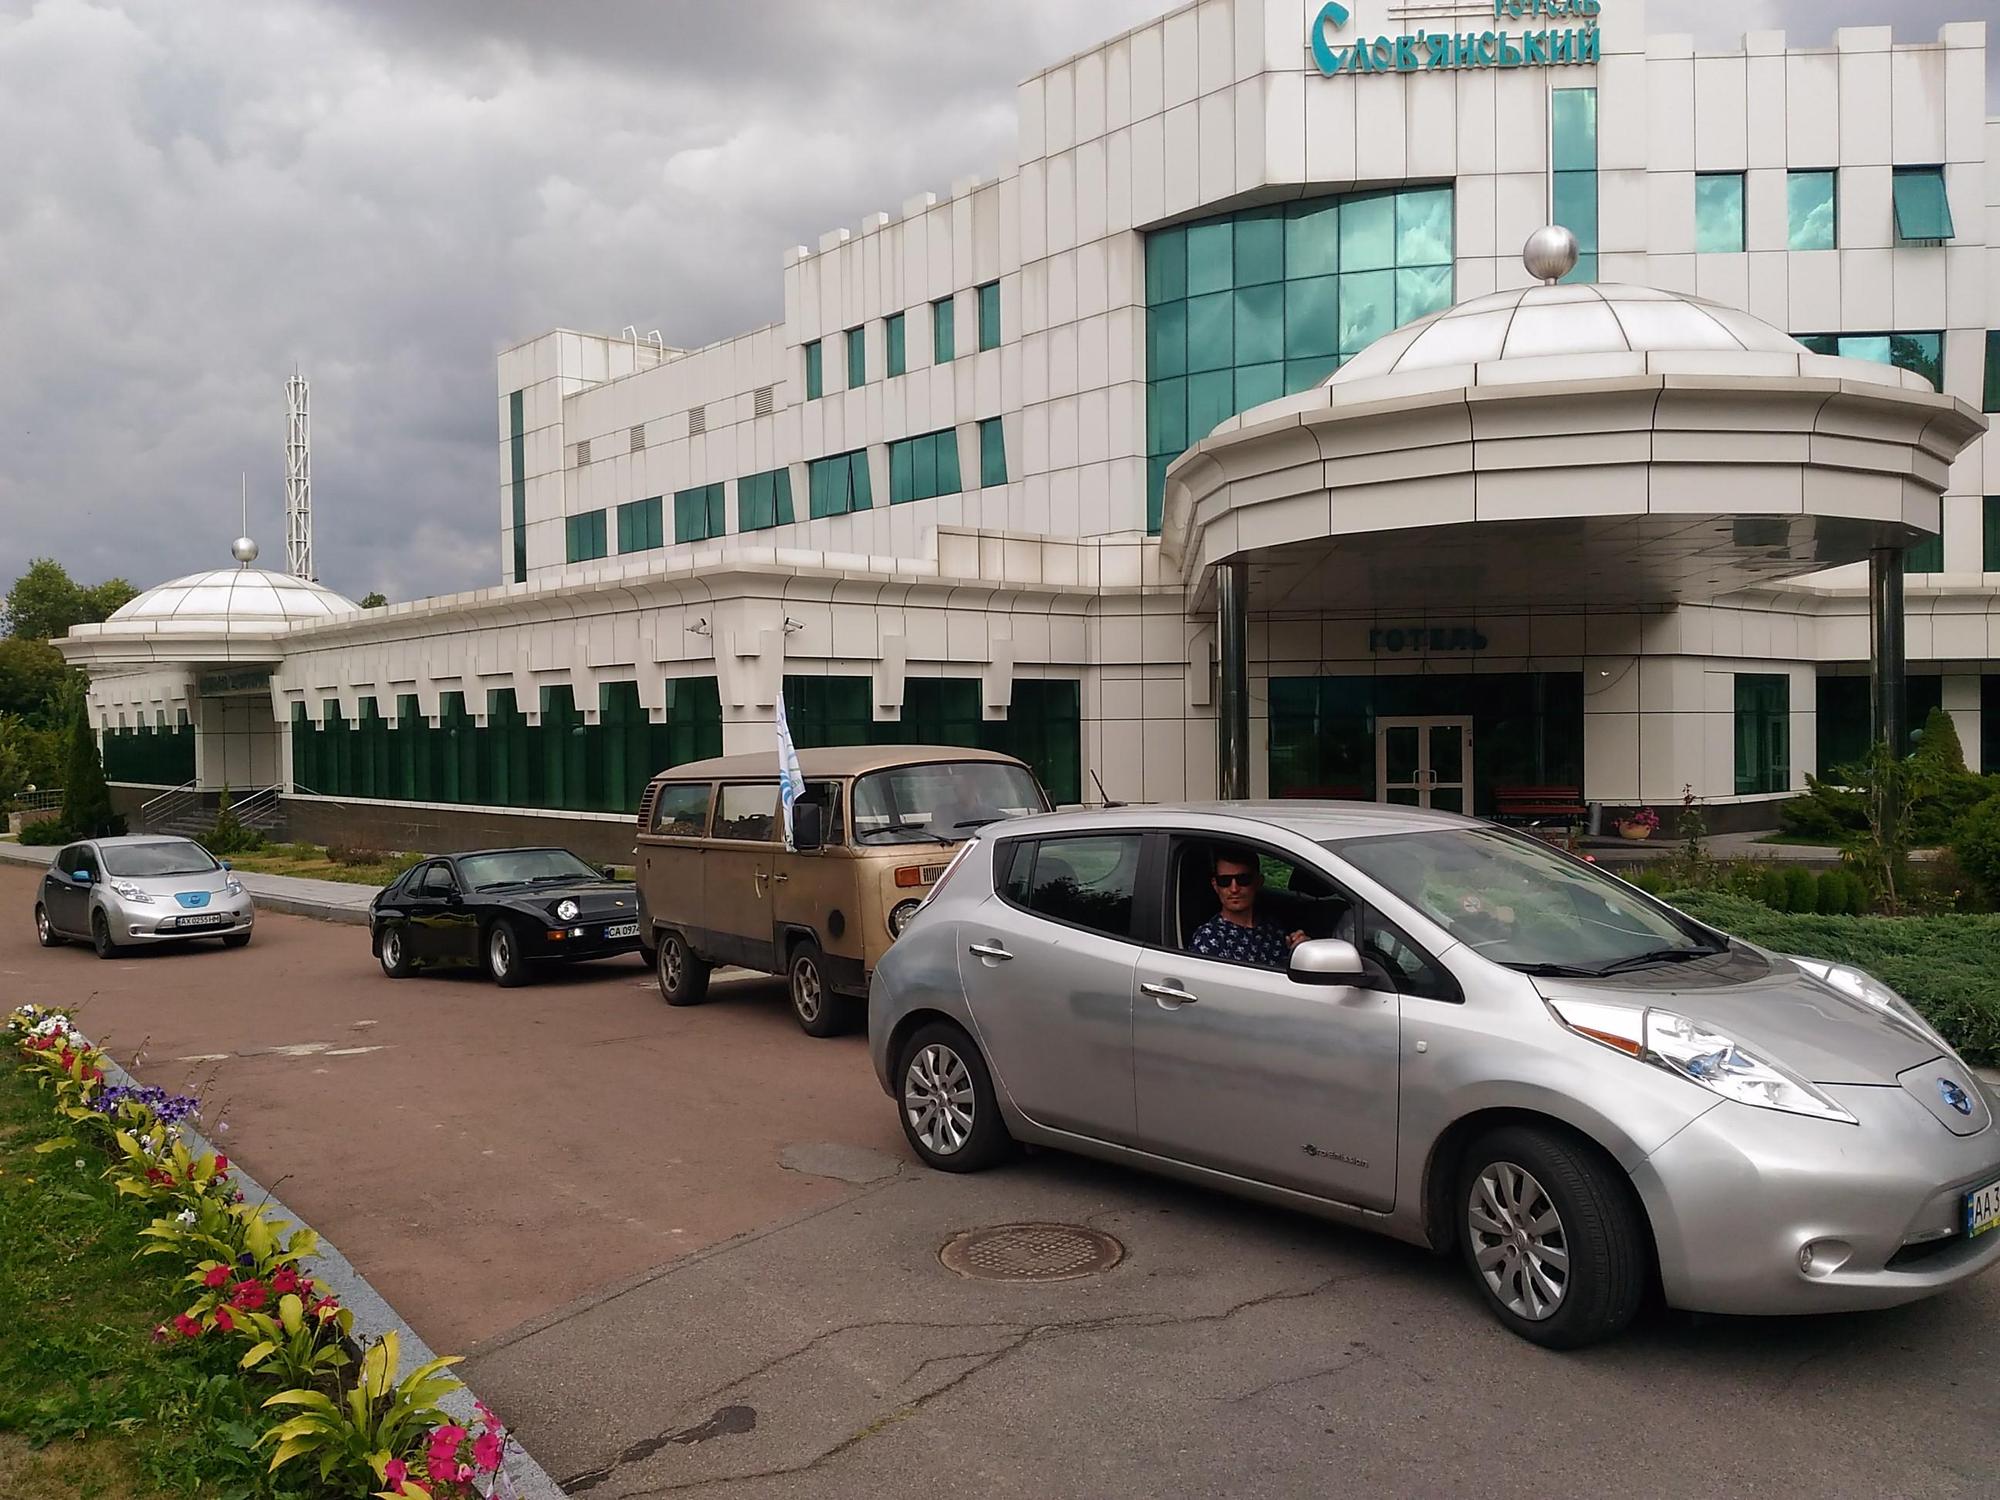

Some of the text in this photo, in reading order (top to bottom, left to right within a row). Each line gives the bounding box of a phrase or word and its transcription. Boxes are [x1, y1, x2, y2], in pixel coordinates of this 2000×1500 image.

[1369, 629, 1487, 652] ГОТЕЛЬ
[609, 927, 621, 936] CA
[1975, 1192, 1991, 1223] AA
